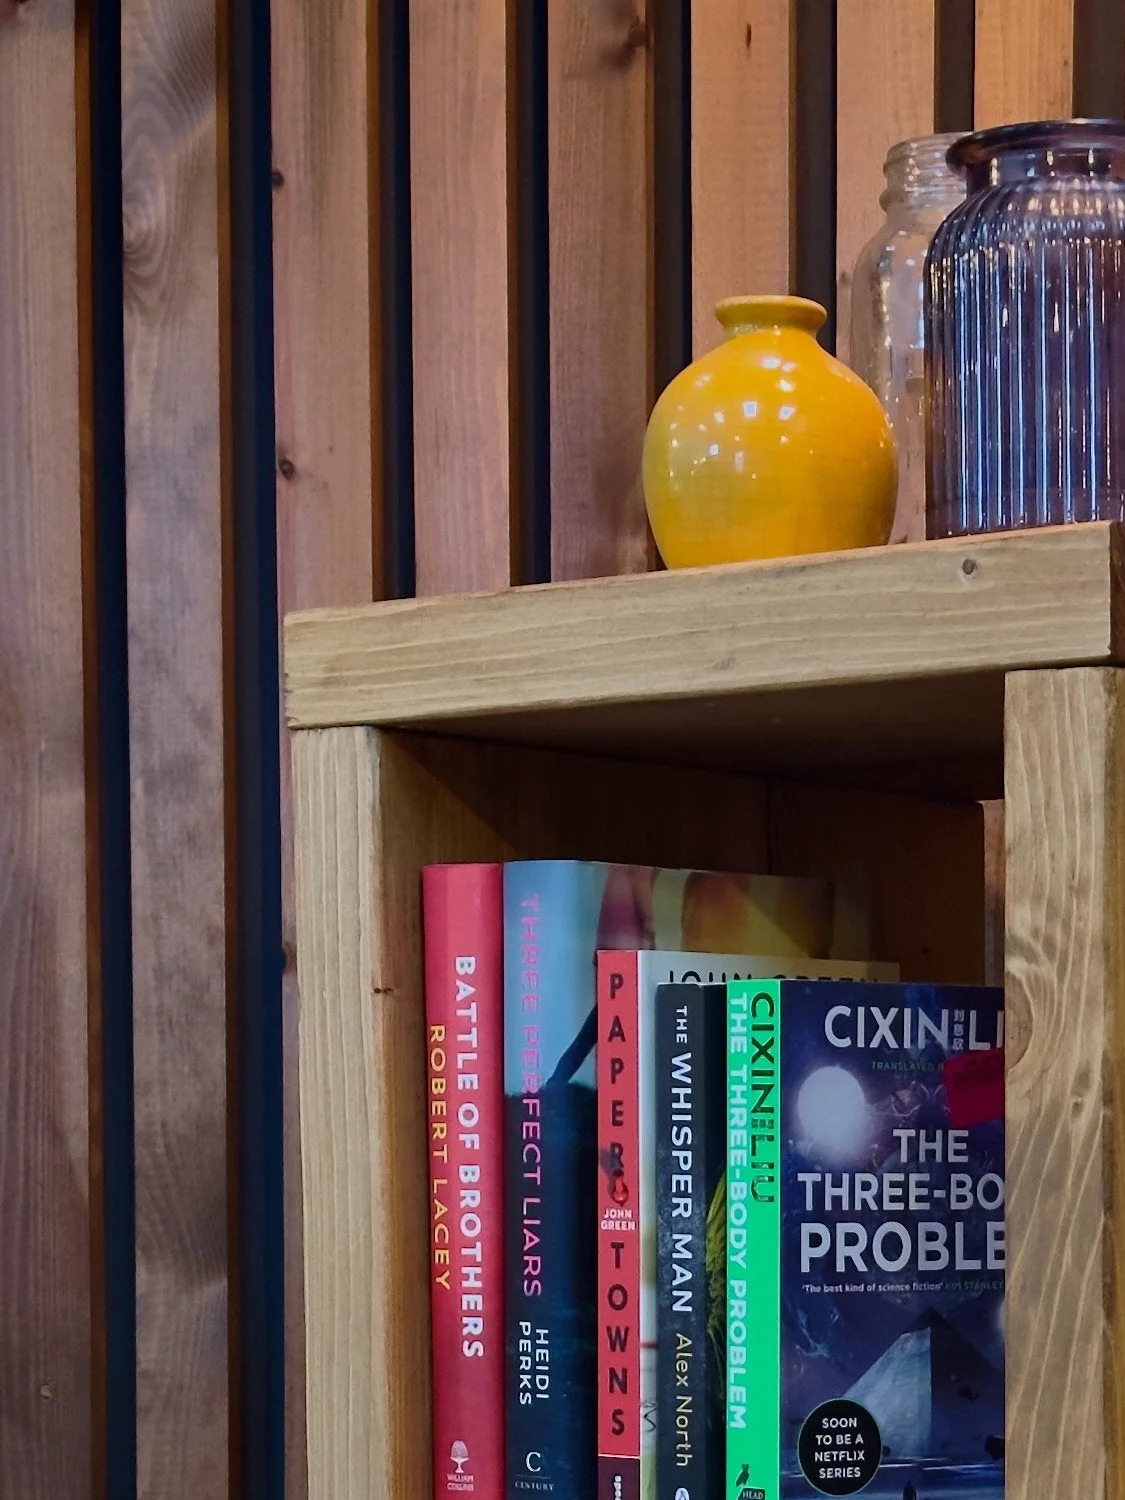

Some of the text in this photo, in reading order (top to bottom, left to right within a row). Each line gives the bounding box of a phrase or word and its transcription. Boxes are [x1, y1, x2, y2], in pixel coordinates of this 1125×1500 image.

[751, 991, 775, 1114] CIXIN
[824, 1004, 950, 1052] CIXIN
[520, 893, 542, 1298] THREE PERFECT LIARS
[607, 972, 626, 1170] PAPER
[871, 1059, 936, 1074] TRANSLATED
[429, 1023, 451, 1291] ROBERT LACEY
[454, 955, 485, 1358] BATTLE OF BROTHERS
[751, 1131, 775, 1204] LIU
[892, 1128, 970, 1164] THE
[600, 1218, 636, 1232] GREEN
[603, 1207, 633, 1220] JOHN
[671, 1005, 693, 1467] THE WHISPER MAN Alex North
[728, 992, 748, 1430] THE THREE-BODY PROBLEM
[823, 1282, 844, 1294] best
[845, 1281, 865, 1294] kind
[866, 1281, 877, 1293] of
[878, 1282, 911, 1293] science
[518, 1320, 533, 1406] PERKS
[535, 1328, 550, 1400] HEIDI
[605, 1241, 630, 1436] TOWNS
[813, 1449, 866, 1463] NETFLIX
[814, 1433, 865, 1447] TO BE A
[820, 1416, 858, 1430] SOON
[818, 1466, 861, 1480] SERIES
